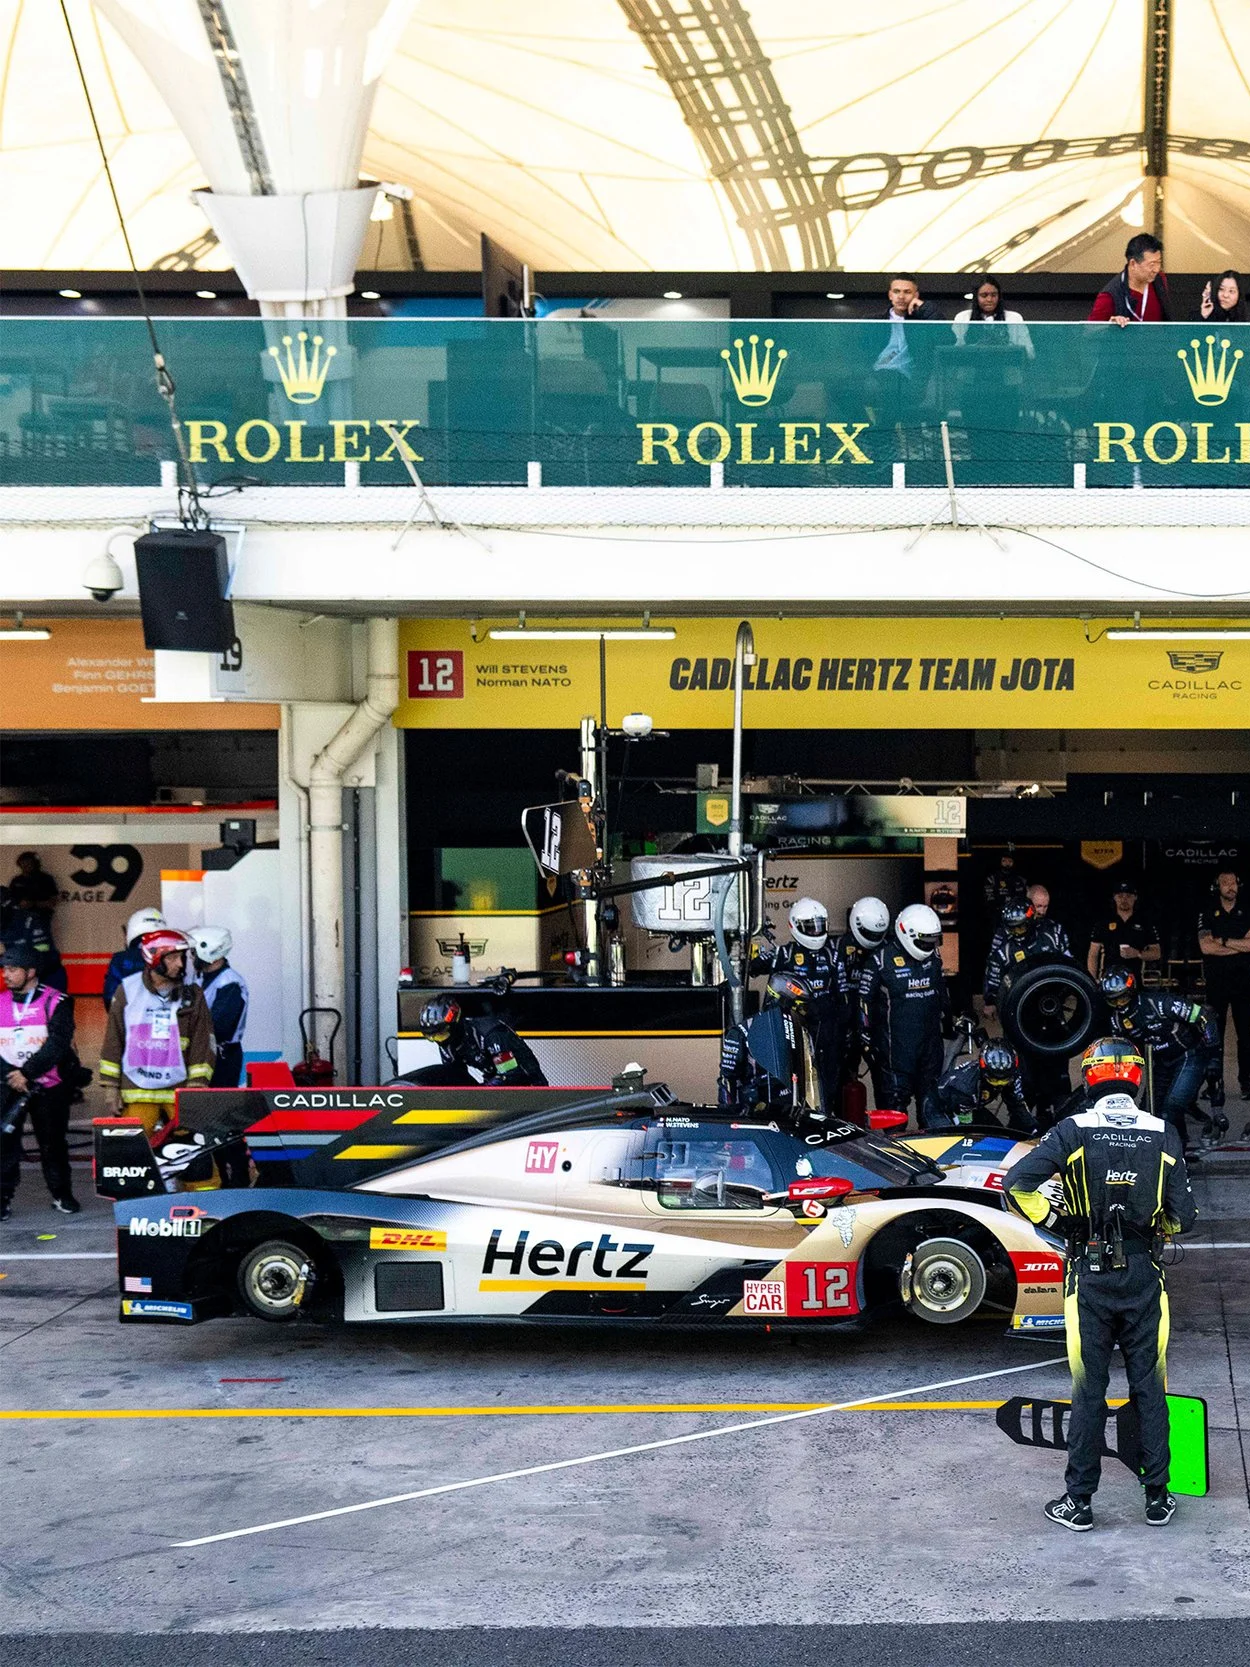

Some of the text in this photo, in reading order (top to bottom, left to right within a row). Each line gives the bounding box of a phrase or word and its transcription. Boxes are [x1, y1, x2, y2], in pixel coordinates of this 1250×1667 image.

[185, 420, 424, 462] ROLEX
[636, 423, 873, 465] ROLEX
[418, 658, 453, 691] 12
[476, 665, 568, 674] Will STEVENS
[818, 657, 912, 691] HERTZ
[919, 657, 995, 691] TEAM
[1000, 658, 1075, 691] JOTA
[476, 678, 571, 688] Norman NATO
[1148, 680, 1242, 690] CADILLAC
[934, 800, 961, 824] 12
[540, 807, 561, 875] 12
[1165, 849, 1238, 857] CADILLAC
[658, 877, 712, 920] 12
[908, 977, 931, 987] Hertz
[273, 1094, 404, 1108] CADILLAC
[962, 1139, 973, 1147] 12
[1093, 1133, 1152, 1143] CADILLAC
[528, 1146, 556, 1169] HY
[103, 1166, 147, 1178] BRADY
[1106, 1169, 1138, 1182] Hertz
[129, 1218, 183, 1237] Mobil
[381, 1233, 437, 1247] DHL
[482, 1229, 655, 1279] Hertz
[1019, 1263, 1059, 1271] JOTA
[746, 1283, 781, 1293] HYPER
[803, 1267, 849, 1310] 12
[1024, 1286, 1057, 1294] dallara
[142, 1304, 187, 1314] MICHELIN
[746, 1295, 783, 1312] CAR
